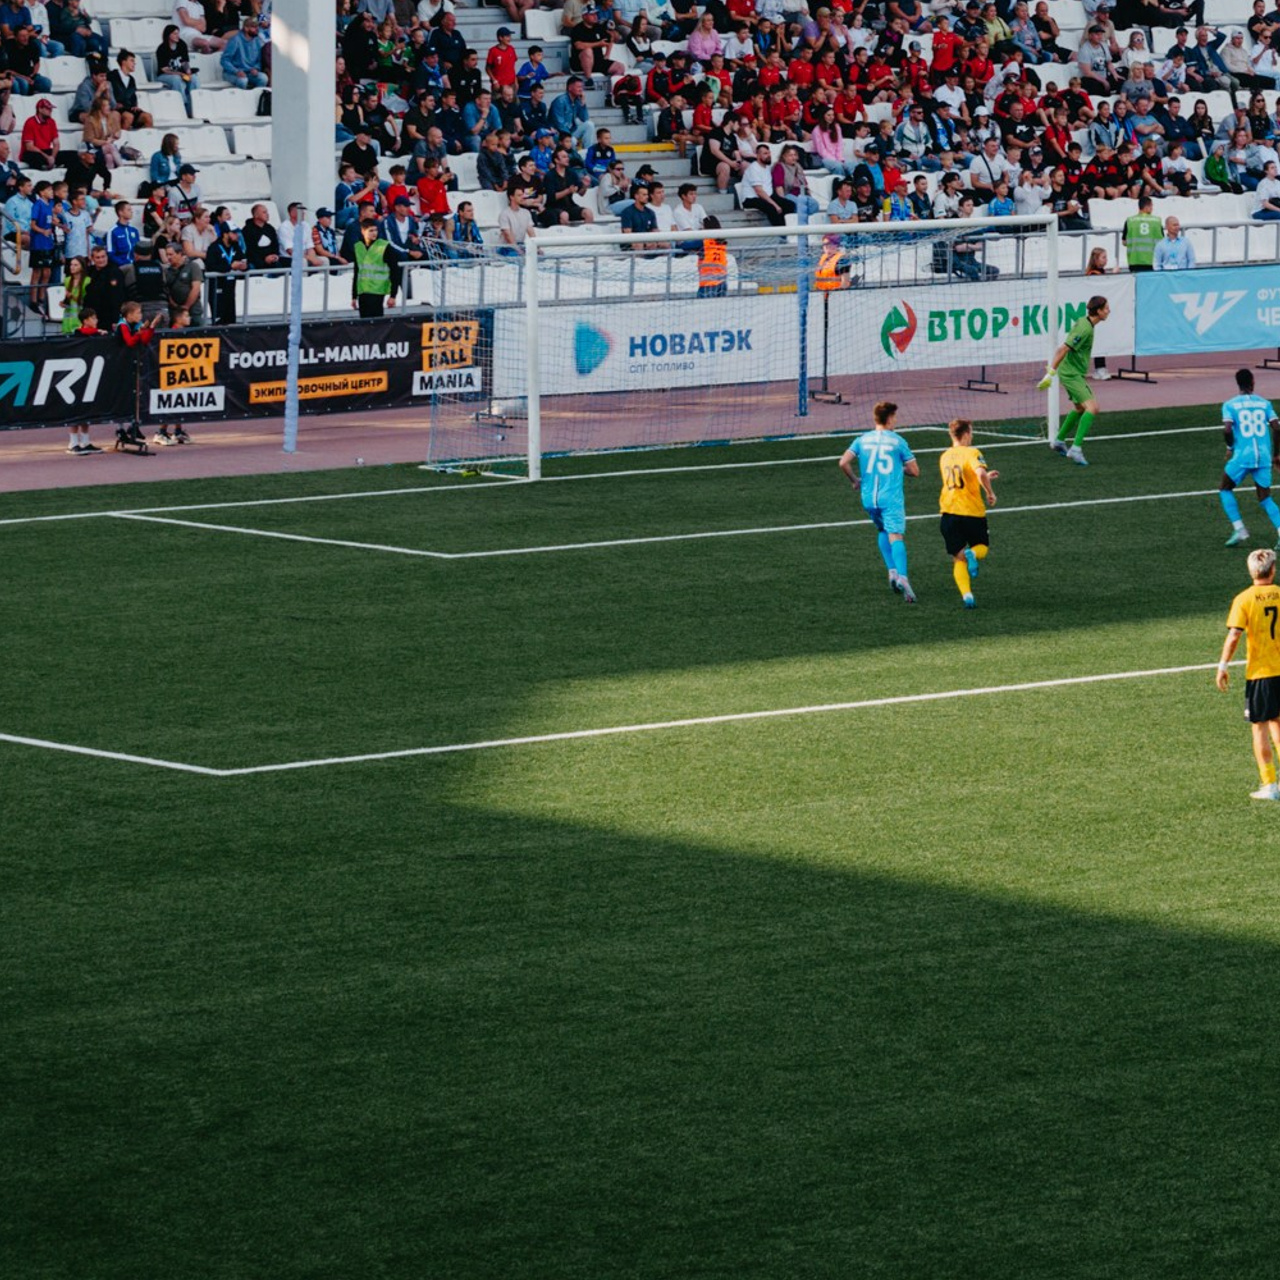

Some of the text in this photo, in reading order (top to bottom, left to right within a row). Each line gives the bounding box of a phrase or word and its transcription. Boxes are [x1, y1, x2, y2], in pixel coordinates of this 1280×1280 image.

[1140, 222, 1150, 235] 8
[428, 325, 471, 342] FOOT
[166, 343, 213, 359] FOOT
[629, 329, 752, 357] НОВАТЭК
[229, 342, 410, 369] FOOTBLL-MANIA.RU
[429, 349, 467, 368] BALL
[166, 366, 208, 386] BALL
[630, 363, 647, 373] СПГ
[351, 377, 384, 392] ЦЕНТР
[419, 373, 475, 391] MANIA
[157, 392, 217, 409] MANIA
[1238, 409, 1266, 437] 88
[863, 444, 894, 474] 75
[1264, 606, 1278, 640] 7
